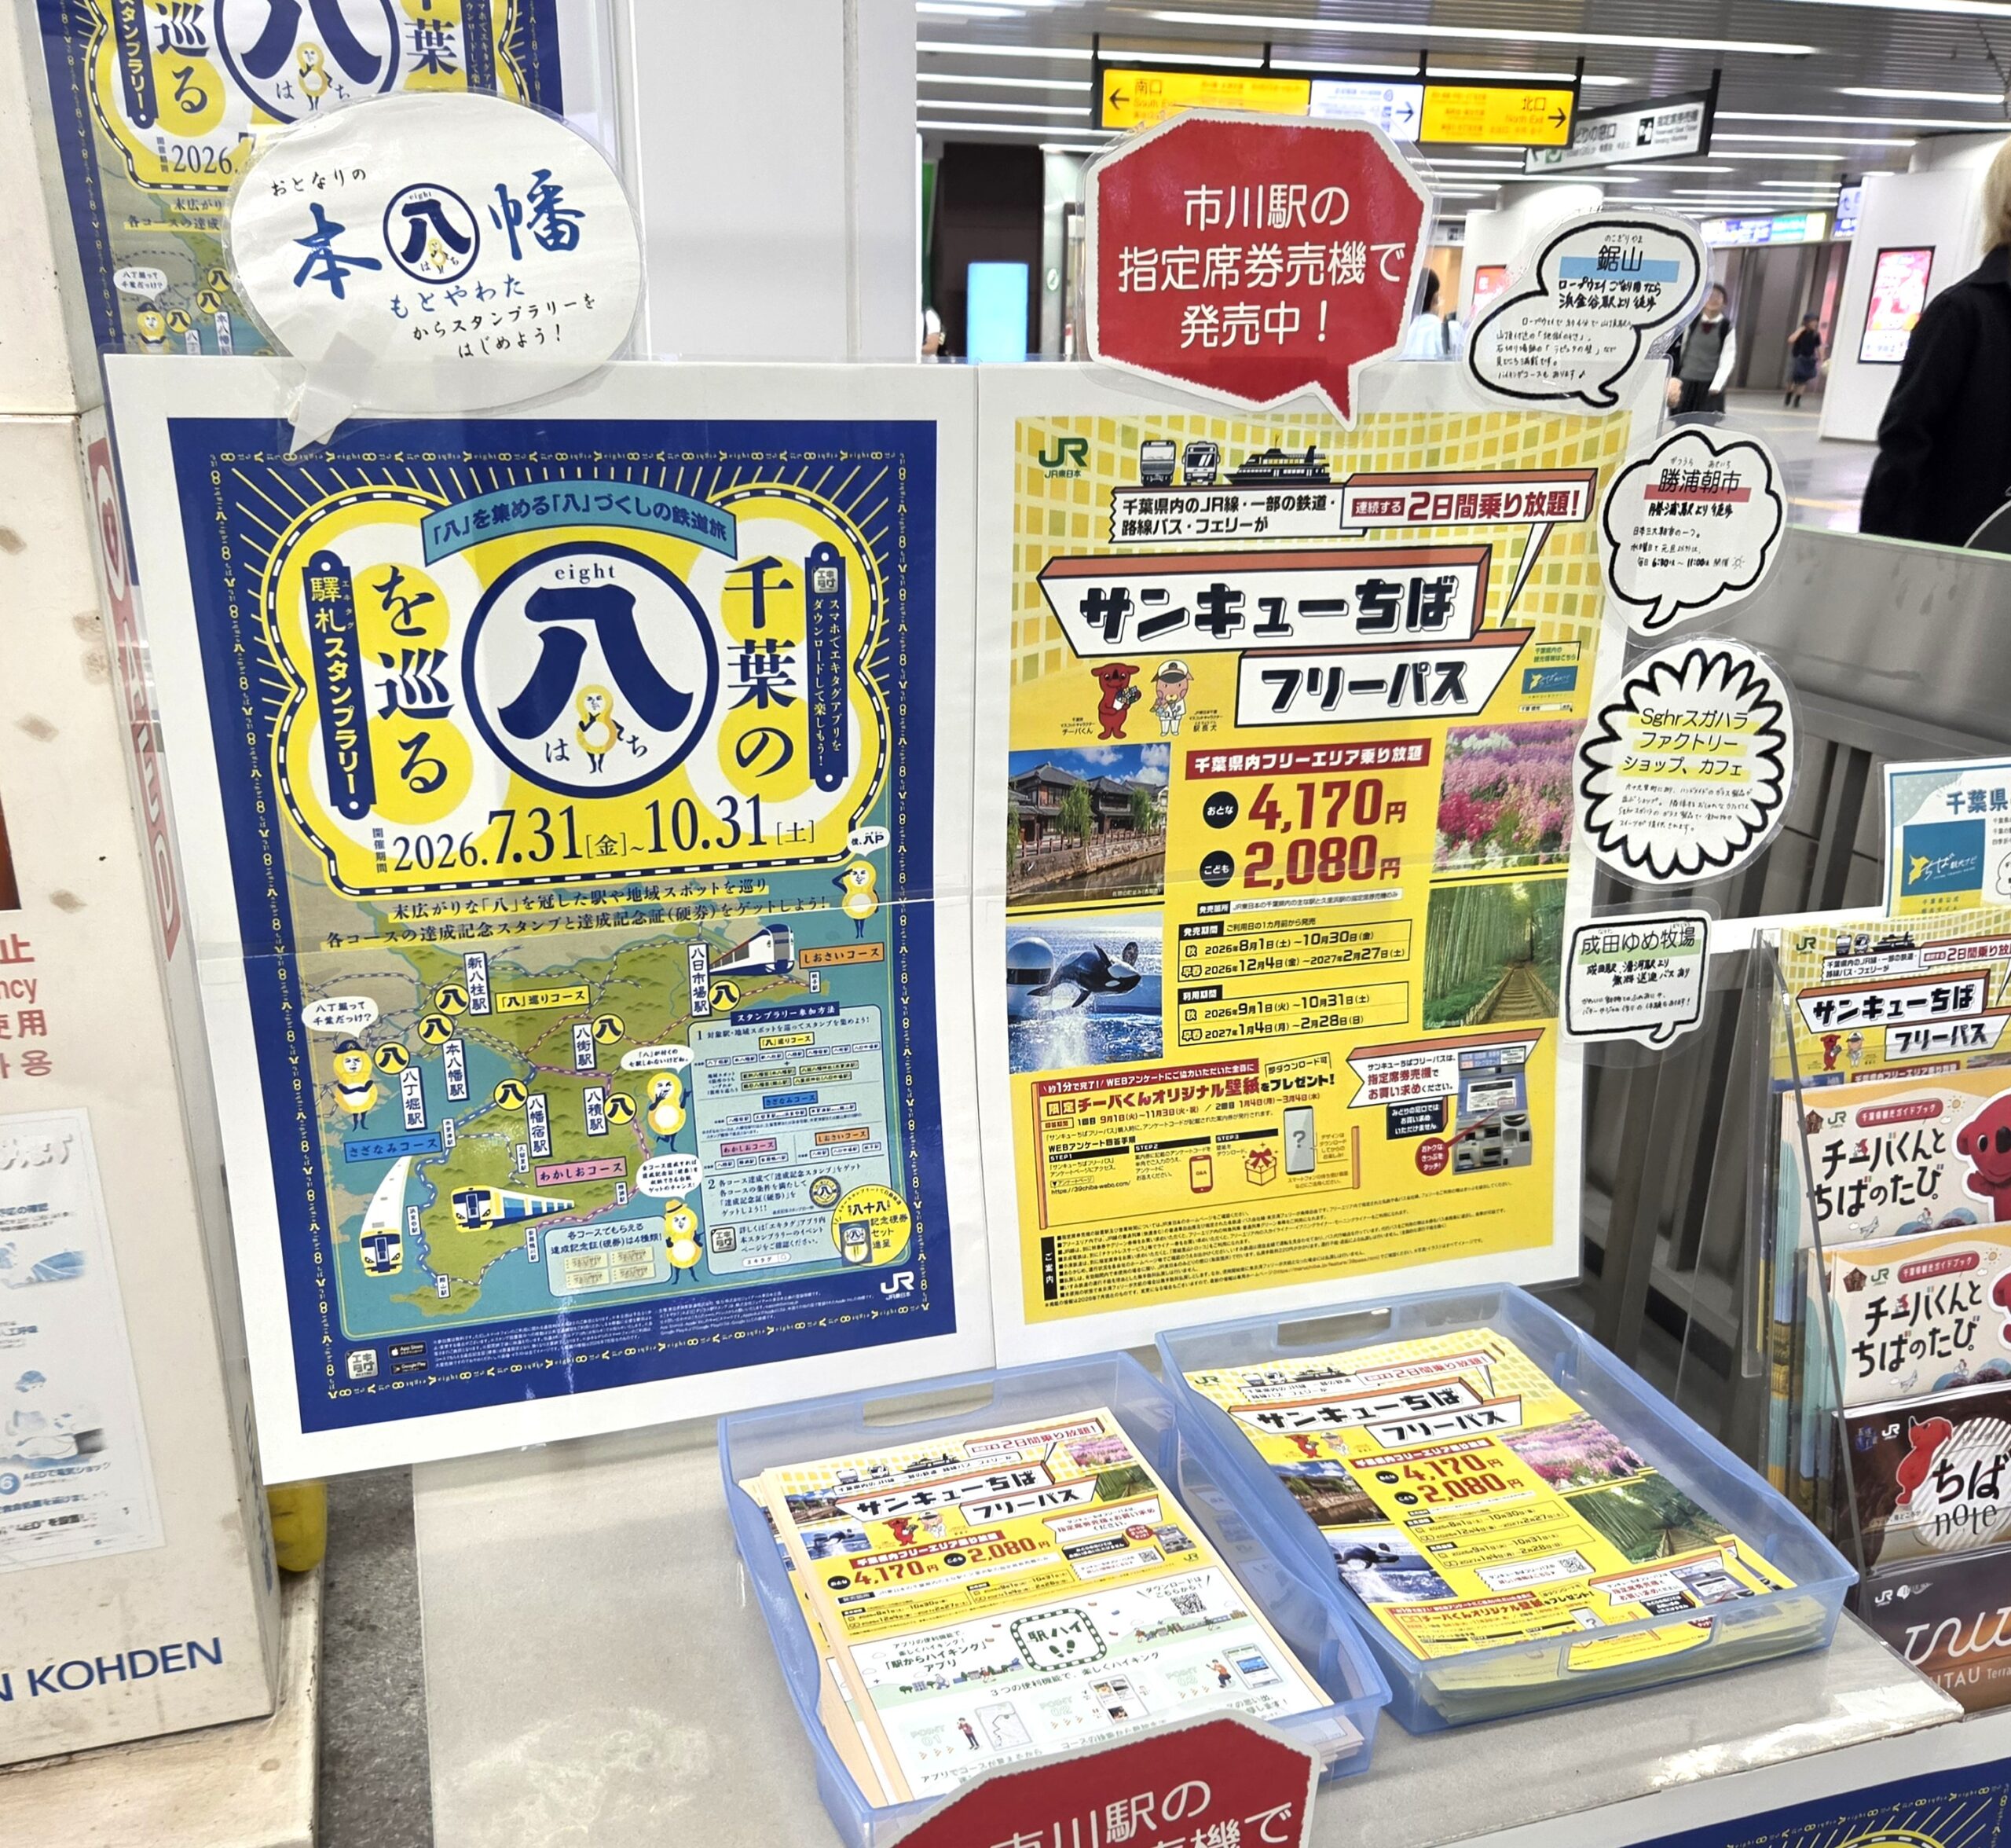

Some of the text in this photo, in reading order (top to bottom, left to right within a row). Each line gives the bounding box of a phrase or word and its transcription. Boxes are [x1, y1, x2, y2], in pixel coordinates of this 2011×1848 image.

[1522, 97, 1547, 112] 北口
[272, 167, 367, 196] おとなりの
[1184, 183, 1350, 232] 市川駅の
[1117, 240, 1407, 293] 指定席券売機で
[1595, 244, 1644, 273] 鋸山
[390, 273, 526, 319] もとやわた
[412, 292, 597, 342] からスタンプラリーを
[1179, 300, 1329, 350] 発売中！
[1038, 438, 1089, 469] JR
[1044, 469, 1082, 478] JR東日本
[1658, 468, 1742, 495] 勝浦朝市
[1354, 500, 1402, 515] 連続する
[1121, 515, 1269, 537] 路線バス・フェリーが
[554, 563, 616, 585] eight
[1079, 574, 1459, 644] サンキューちば
[497, 584, 694, 740] 八
[724, 556, 797, 778] 千葉の
[372, 565, 455, 794] を巡る
[1260, 660, 1469, 713] フリーパス
[1640, 708, 1749, 730] Sghrスガハラ
[1639, 732, 1738, 752] ファクトリー
[1194, 745, 1423, 775] 千葉県内フリーエリア乗り放題
[1207, 778, 1407, 834] おとな 4,170円
[372, 827, 388, 874] 開催期間
[1203, 834, 1401, 891] こども 2,080円
[1183, 926, 1218, 937] 発売期間
[1581, 926, 1695, 955] 成田ゆめ牧場
[1796, 937, 1817, 951] JR
[803, 949, 881, 964] しおさいコース
[467, 956, 487, 1010] 新八柱駅
[690, 948, 708, 1012] 八日市場駅
[737, 1006, 836, 1022] スタンプラリー参加方法
[1812, 983, 1976, 1025] サンキューちば
[576, 1028, 593, 1066] 八街駅
[1895, 1023, 1989, 1053] フリーパス
[446, 1043, 464, 1097] 本八幡駅
[1367, 1067, 1439, 1087] 指定席券売機で
[402, 1070, 423, 1126] 八丁堀駅
[1368, 1082, 1454, 1101] お買い求めください。
[529, 1098, 548, 1153] 八幡宿駅
[587, 1091, 604, 1131] 八積駅
[1827, 1110, 1847, 1124] JR
[349, 1138, 439, 1158] さざなみコース
[1135, 1143, 1159, 1152] STEP2
[1216, 1134, 1240, 1142] STEP3
[1822, 1128, 1946, 1180] チーバくんと
[539, 1161, 624, 1182] わかしおコース
[880, 1270, 915, 1295] JR
[1865, 1280, 1982, 1336] チーバくんと
[1256, 1387, 1463, 1430] サンキューちば
[1381, 1410, 1509, 1442] フリーパス
[1881, 1423, 1900, 1437] JR
[1403, 1454, 1504, 1483] 4,170円
[1932, 1451, 2011, 1505] ちば
[856, 1470, 1038, 1516] サンキューちば
[972, 1487, 1082, 1519] フリーパス
[1416, 1474, 1525, 1505] 2,080円
[1935, 1503, 1997, 1537] note
[967, 1538, 1051, 1564] 2,080円
[853, 1561, 940, 1586] 4,170円
[1027, 1621, 1083, 1644] 駅ハイ
[28, 1637, 224, 1698] KOHDEN
[924, 1659, 957, 1673] アプリ
